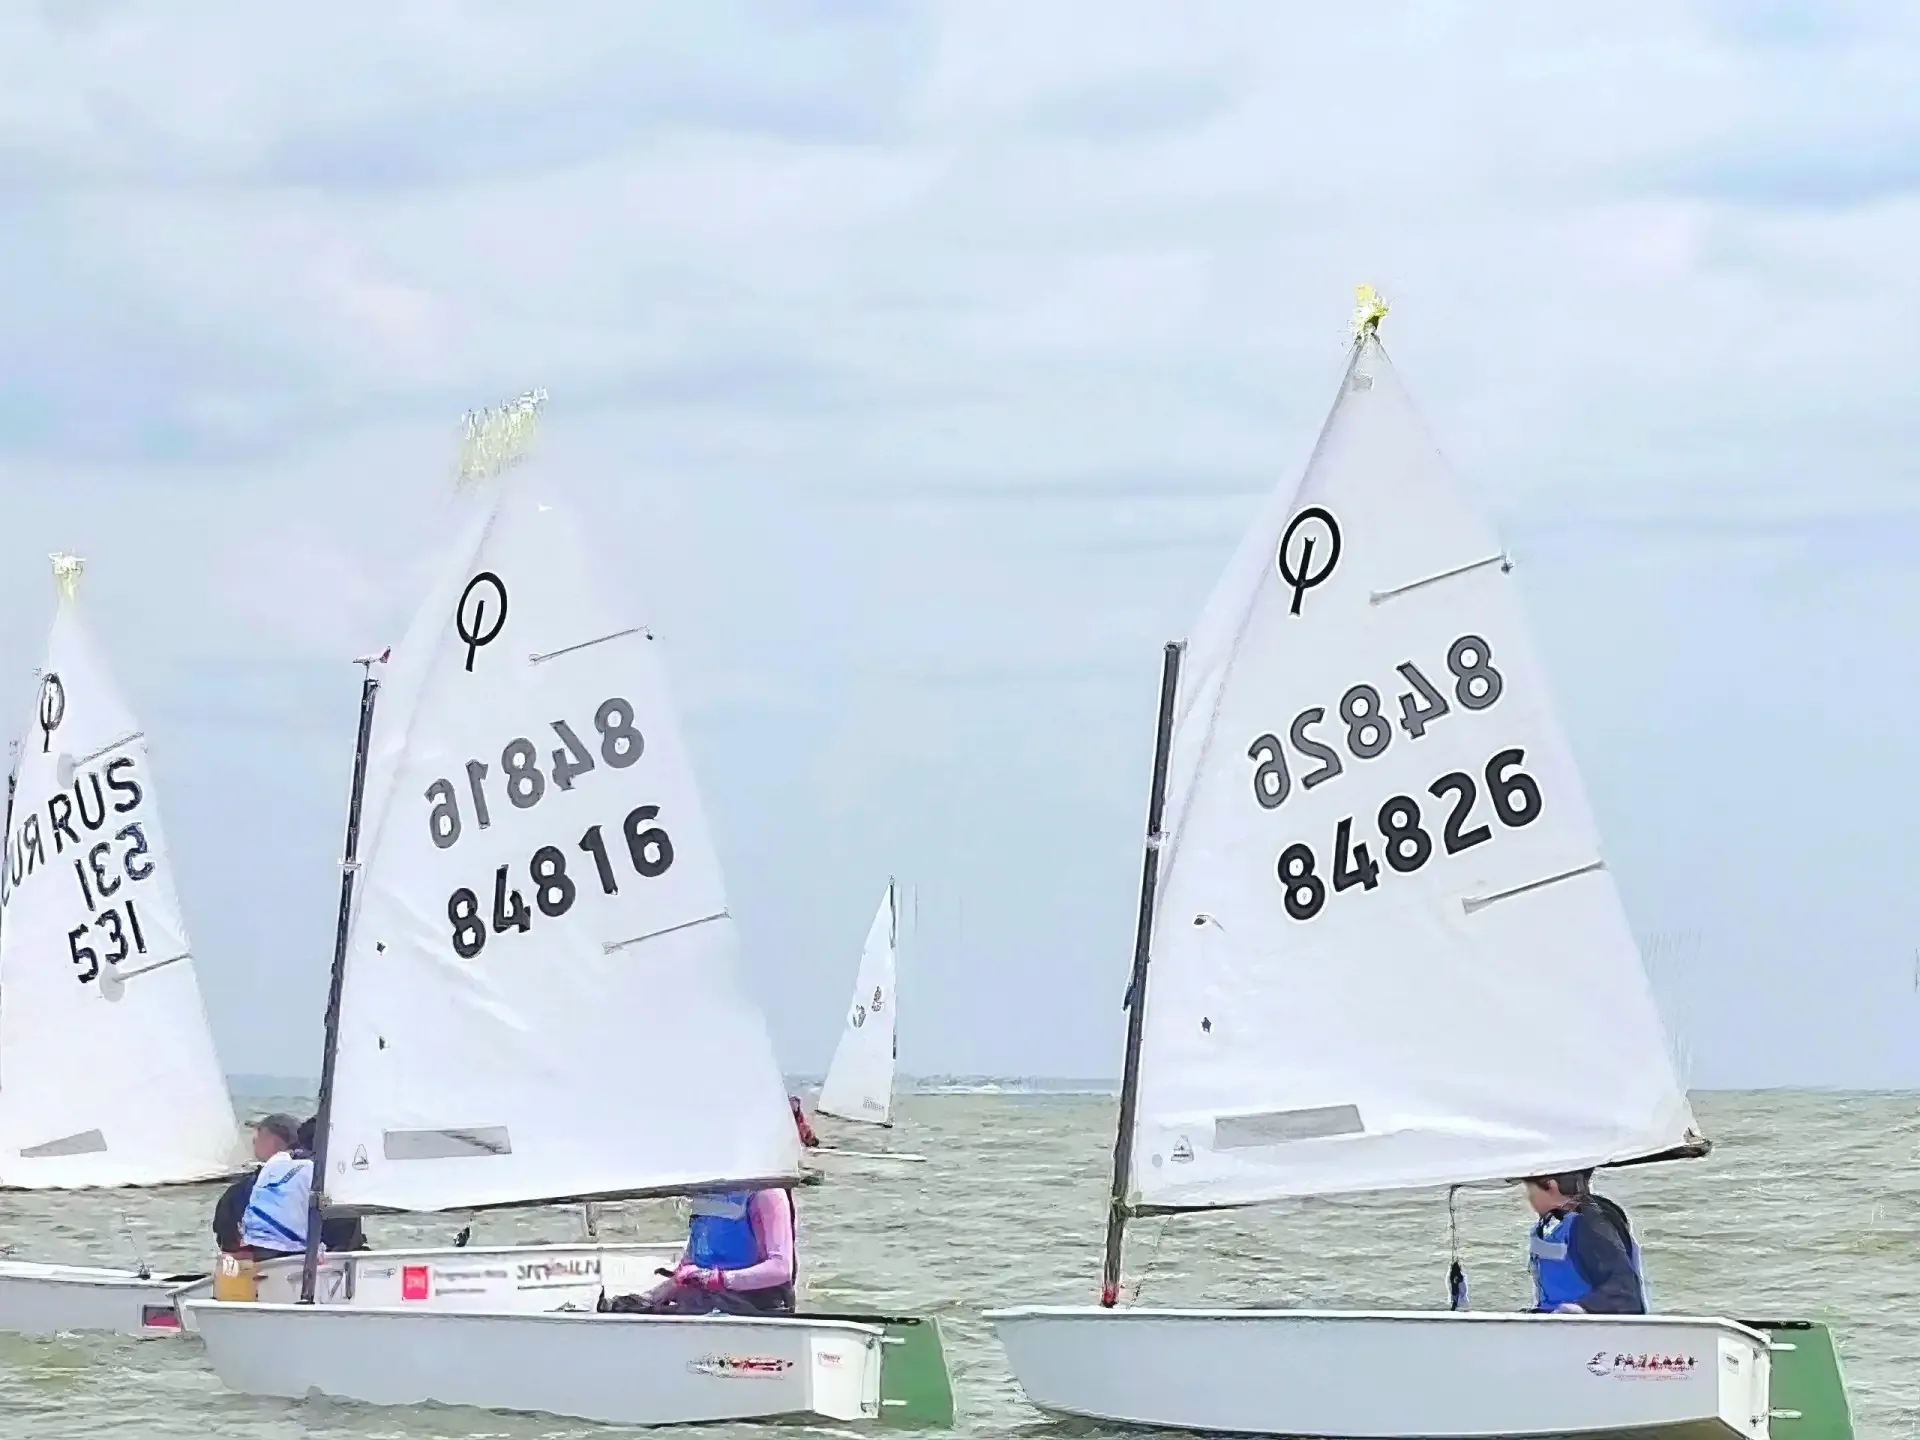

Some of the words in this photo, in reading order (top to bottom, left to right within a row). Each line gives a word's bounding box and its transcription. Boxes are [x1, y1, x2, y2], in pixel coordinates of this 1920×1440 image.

[48, 757, 143, 854] RUS
[1277, 748, 1543, 921] 84826
[68, 900, 147, 984] 531
[447, 804, 675, 959] 84816
